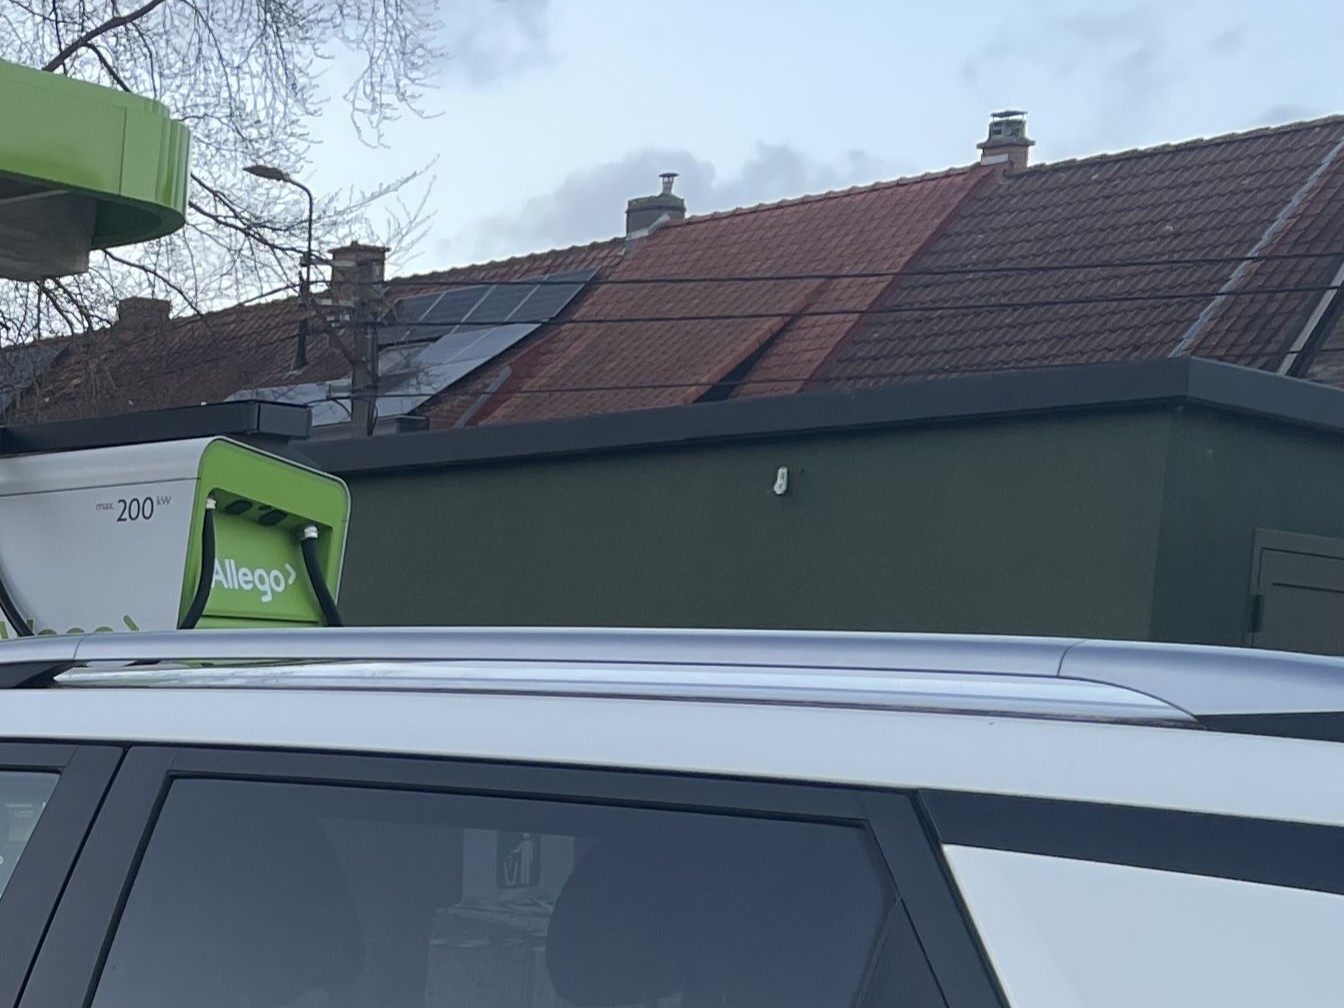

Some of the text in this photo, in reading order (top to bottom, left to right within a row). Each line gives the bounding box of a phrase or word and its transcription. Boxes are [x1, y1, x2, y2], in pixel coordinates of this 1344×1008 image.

[116, 497, 154, 522] 200
[156, 495, 172, 506] kW
[212, 558, 286, 602] Allego
